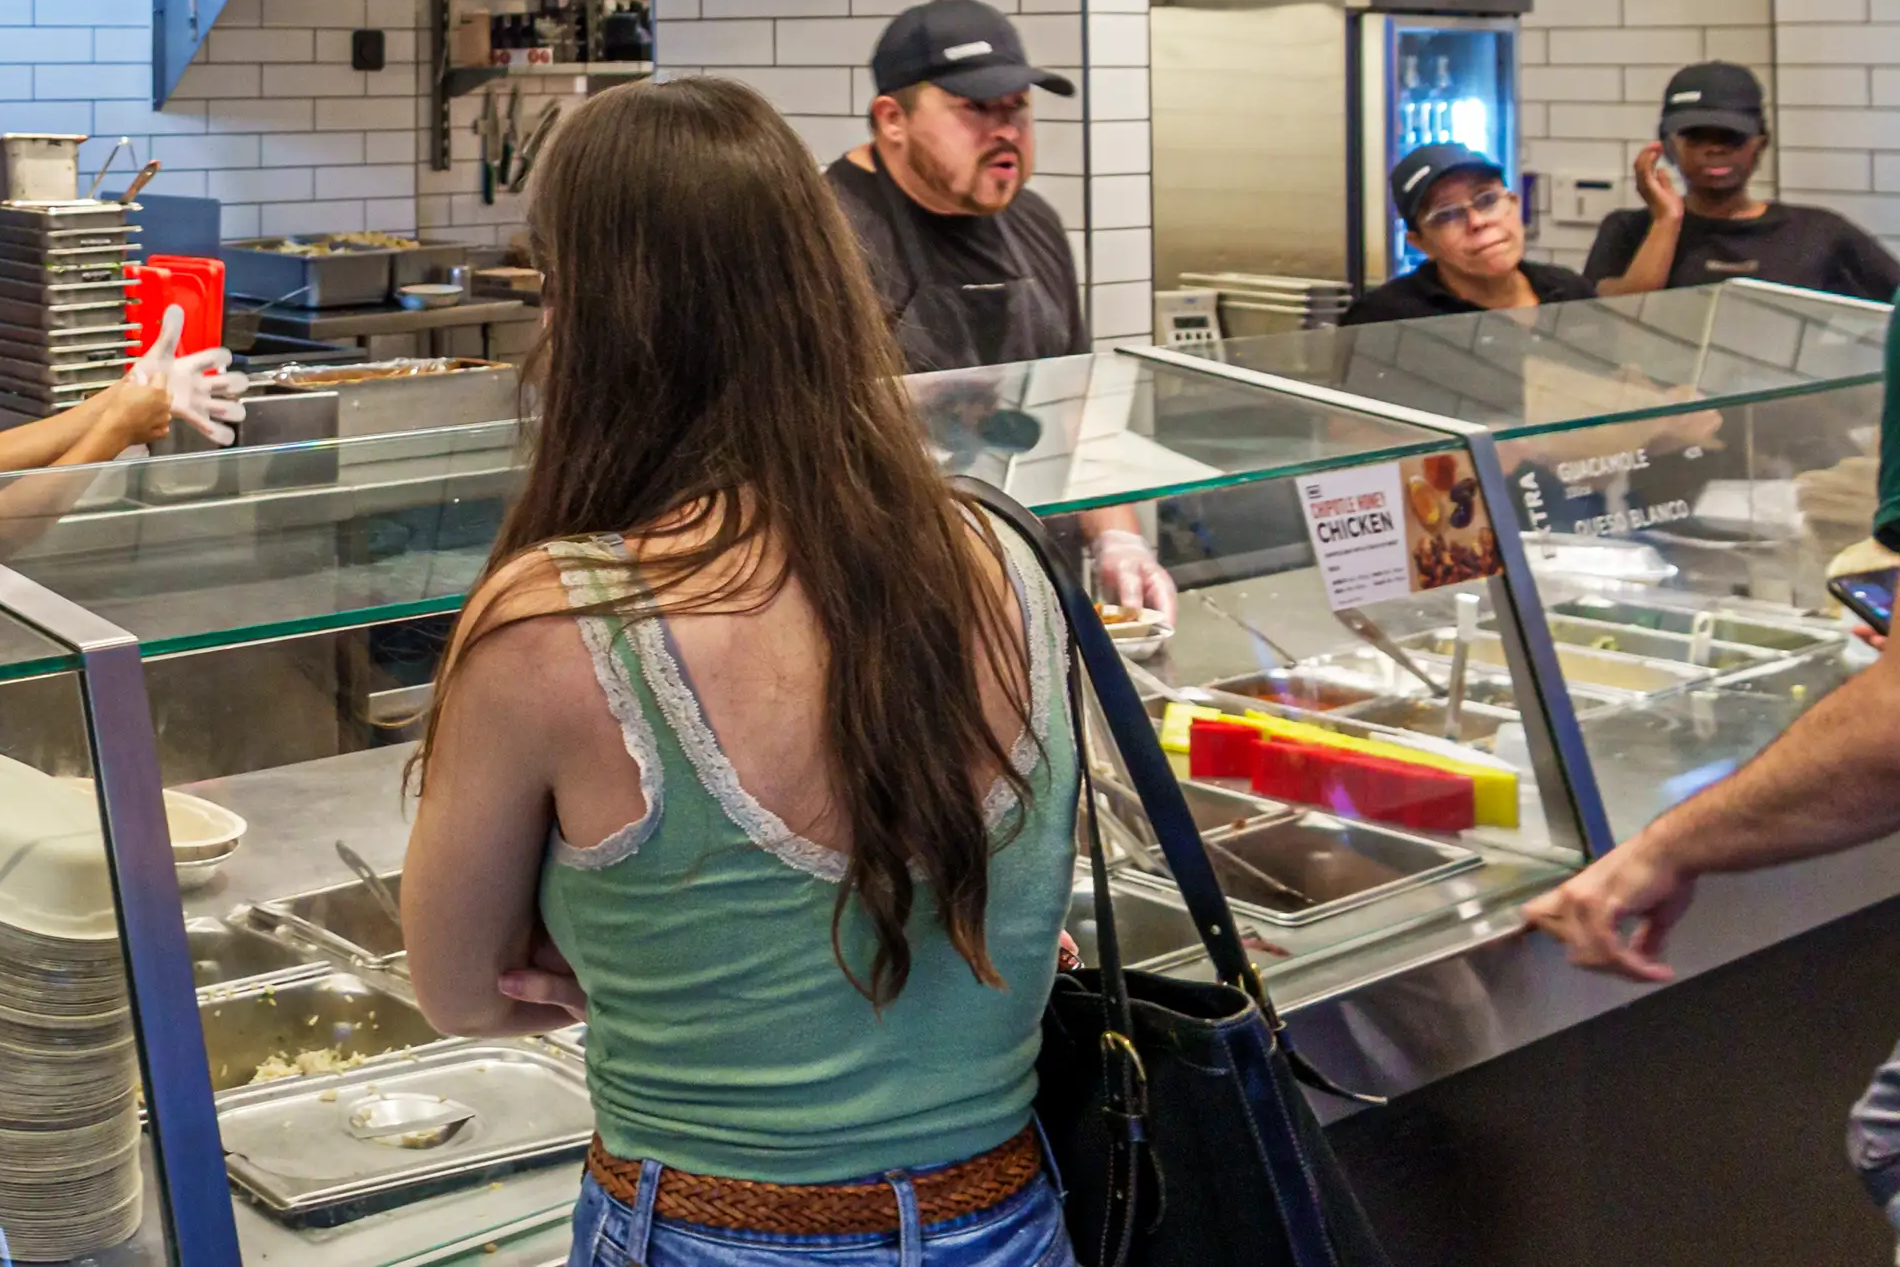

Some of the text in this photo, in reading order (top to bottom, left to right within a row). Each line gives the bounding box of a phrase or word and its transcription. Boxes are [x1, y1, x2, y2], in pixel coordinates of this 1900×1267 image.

[1556, 447, 1651, 482] GUACAMOLE
[1316, 510, 1394, 543] CHICKEN
[1574, 498, 1690, 536] QUESO BLANCO
